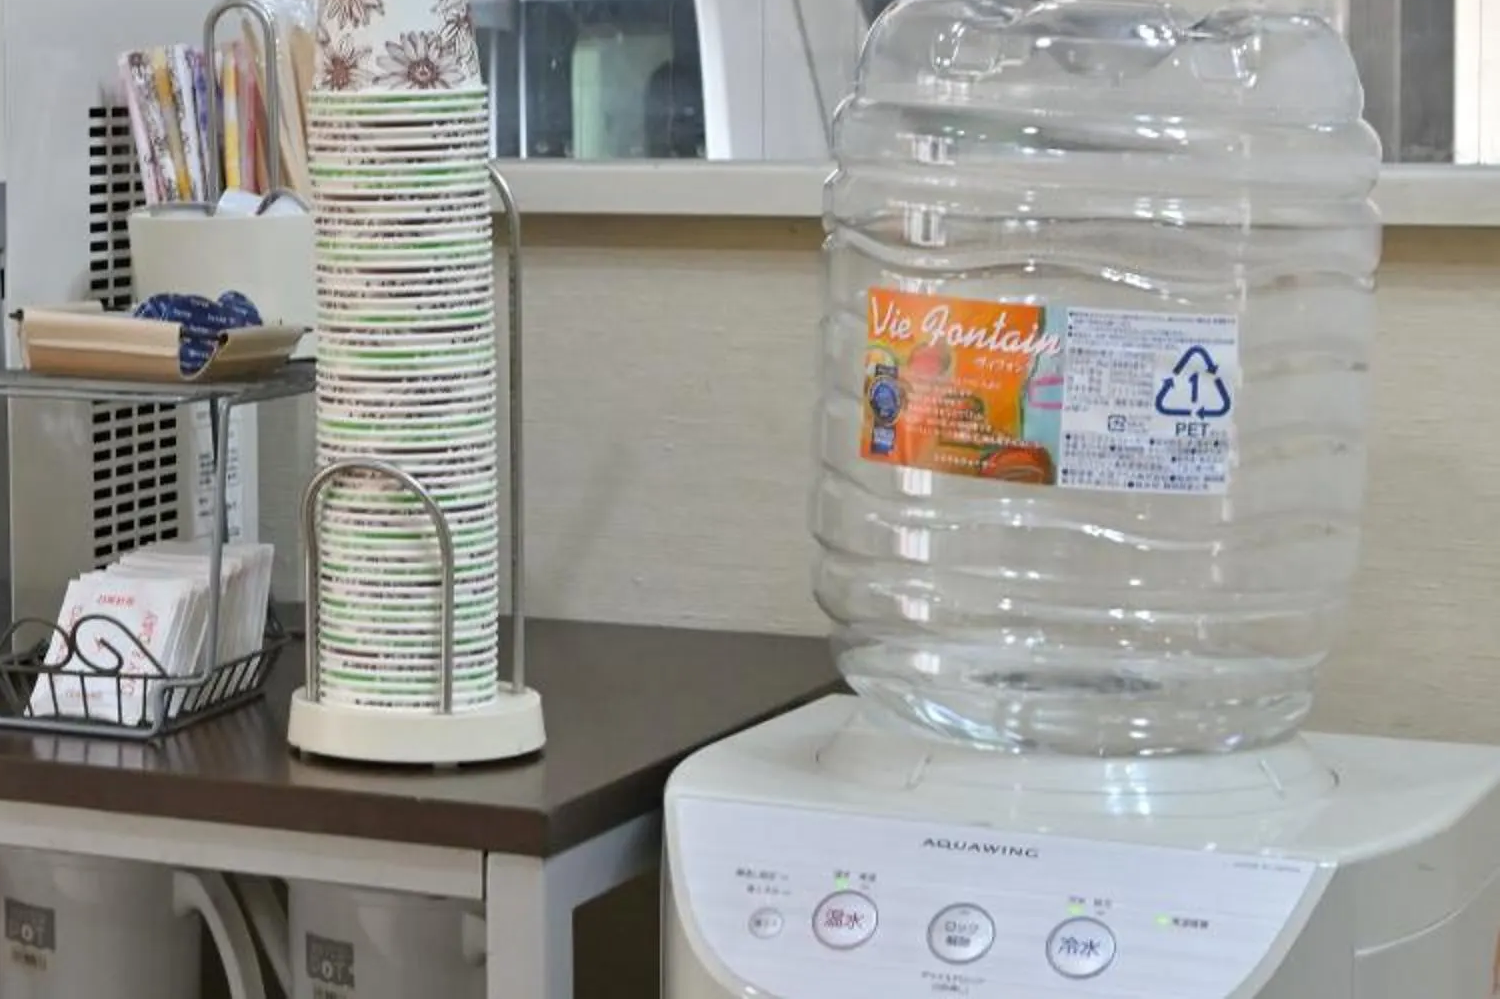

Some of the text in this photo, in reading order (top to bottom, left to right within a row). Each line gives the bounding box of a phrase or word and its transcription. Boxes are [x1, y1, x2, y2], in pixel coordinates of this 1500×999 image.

[871, 296, 912, 339] Vie
[1175, 422, 1211, 437] PET
[922, 837, 1040, 859] AQUAWING
[824, 908, 865, 929] 温水
[1058, 936, 1100, 958] 冷水
